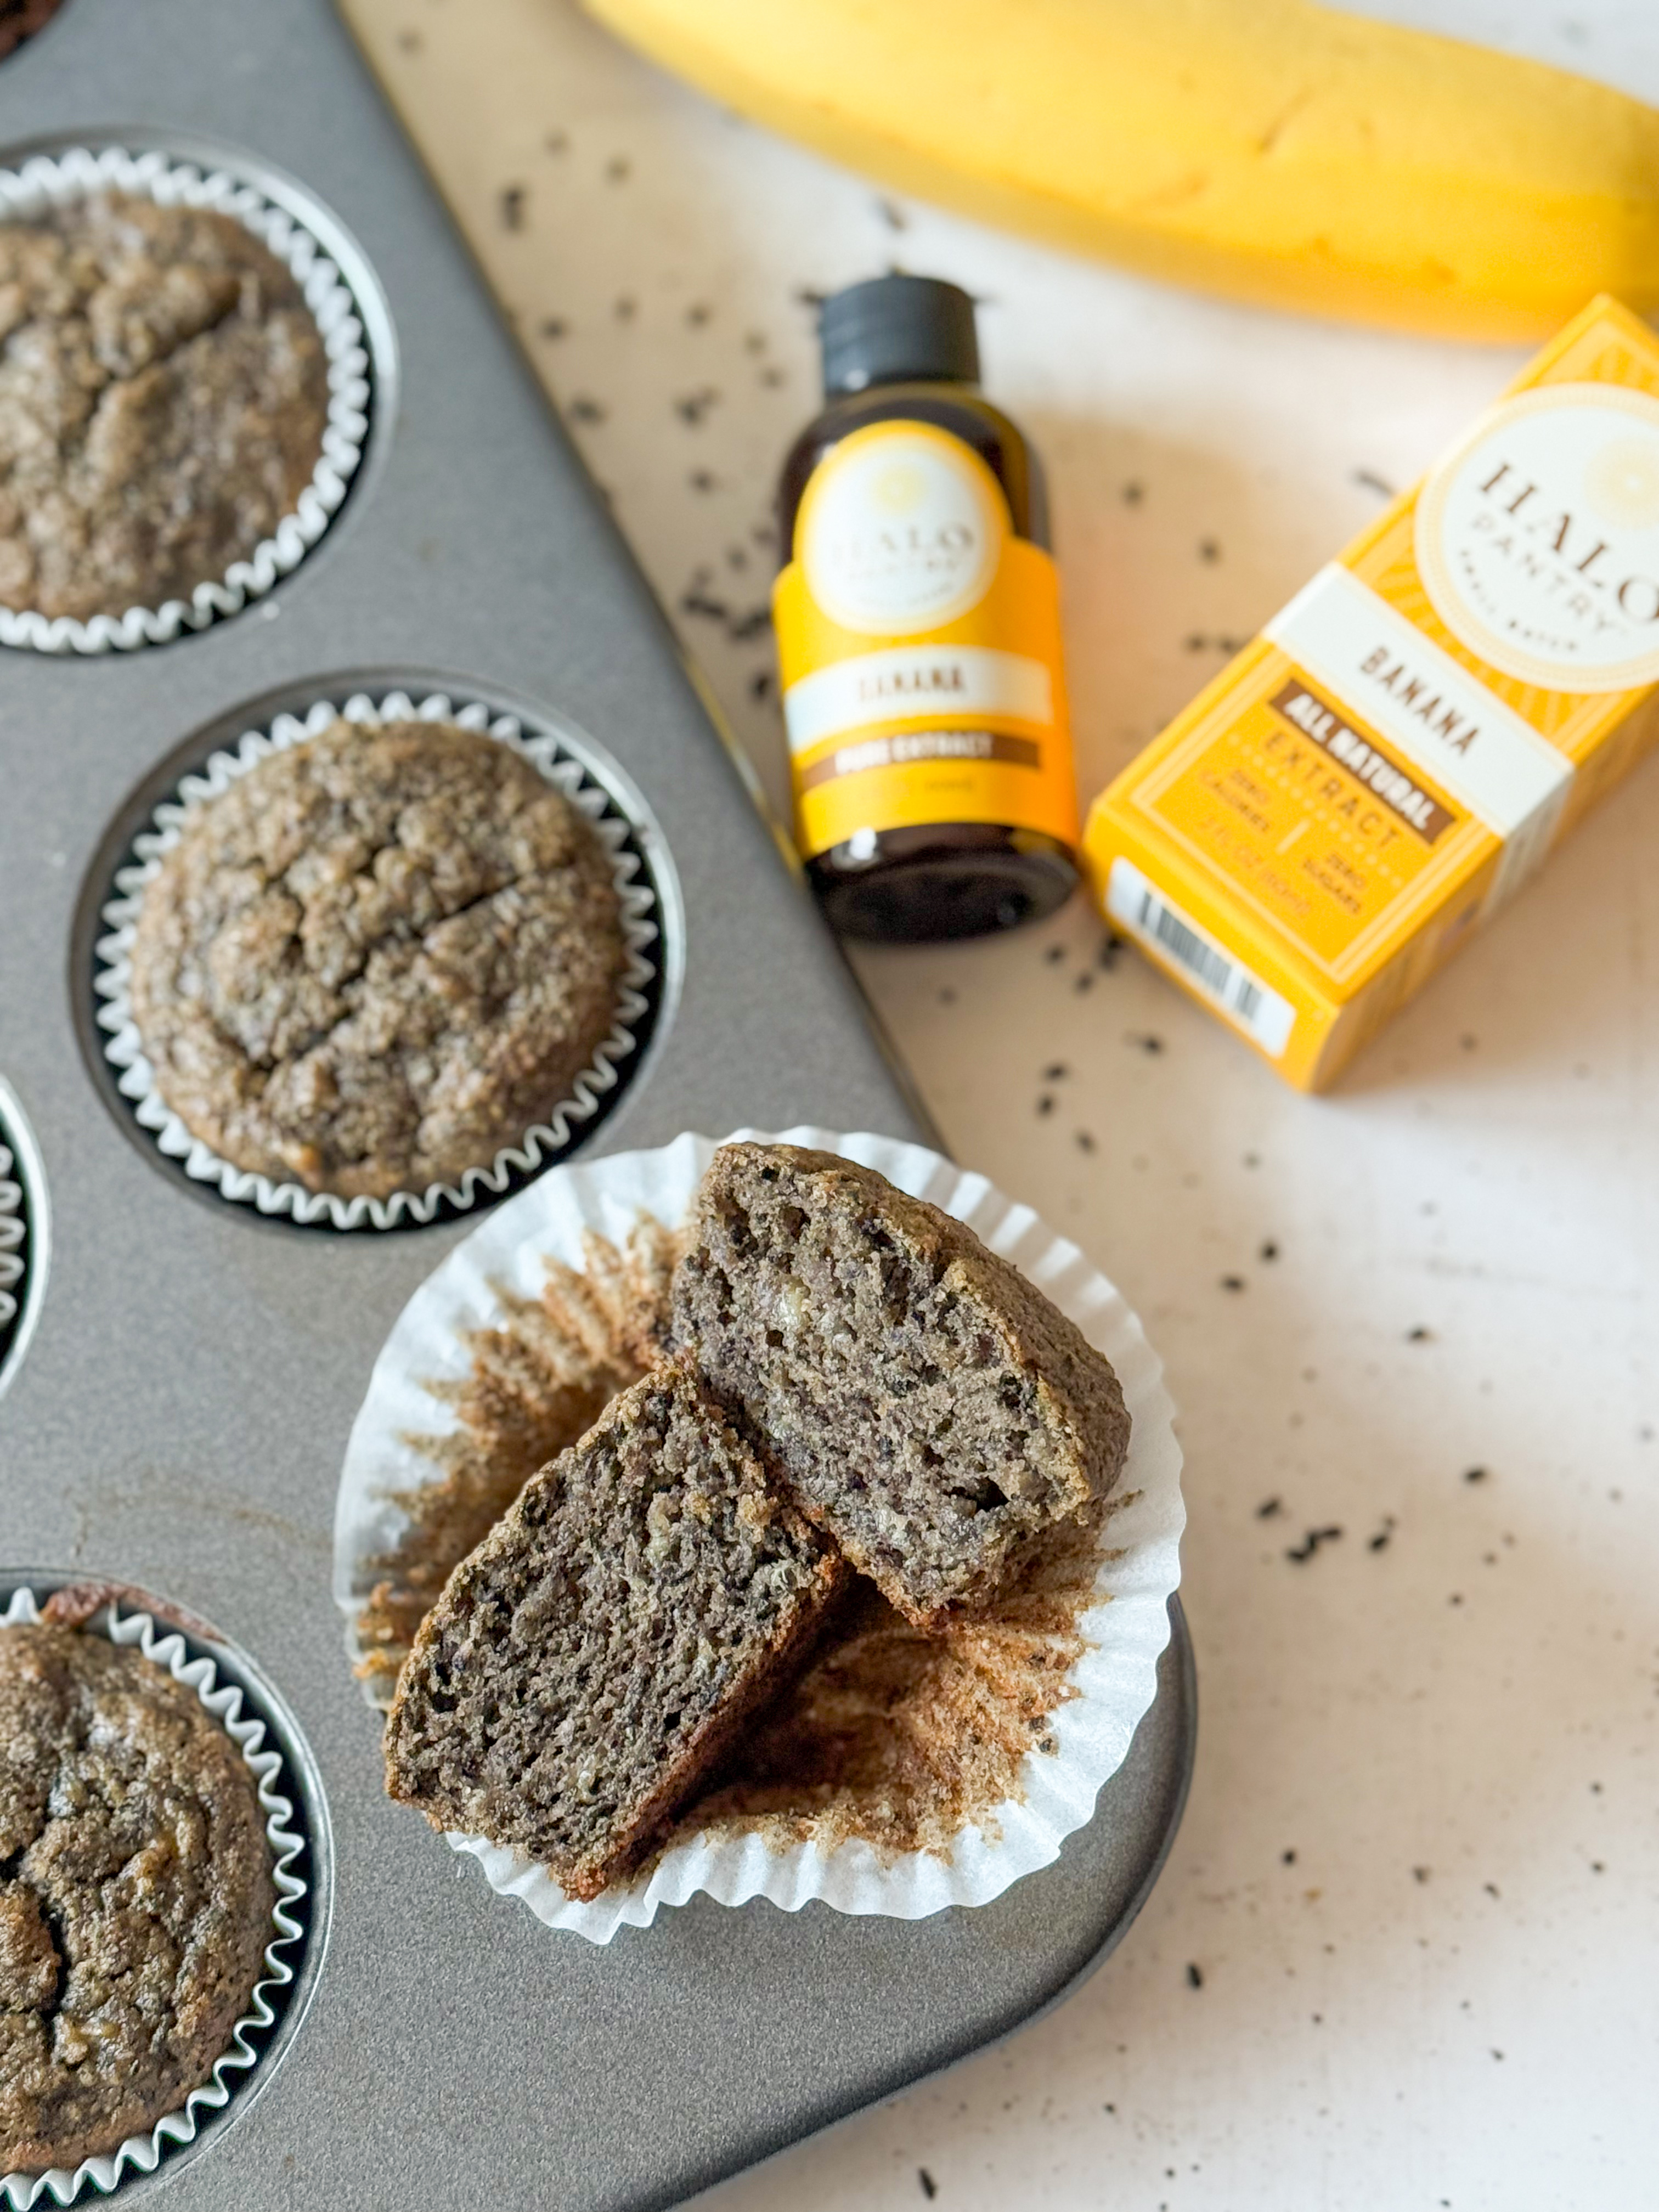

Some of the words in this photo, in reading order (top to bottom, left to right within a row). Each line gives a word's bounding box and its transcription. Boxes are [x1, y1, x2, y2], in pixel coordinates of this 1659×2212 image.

[1469, 509, 1620, 634] PANTRY
[1480, 462, 1659, 624] HALO
[890, 730, 993, 763] EXTRACT
[1360, 645, 1479, 755] BANANA
[1265, 731, 1400, 847] EXTRACT
[1283, 692, 1335, 743] ALL
[1327, 728, 1435, 830] NATURAL
